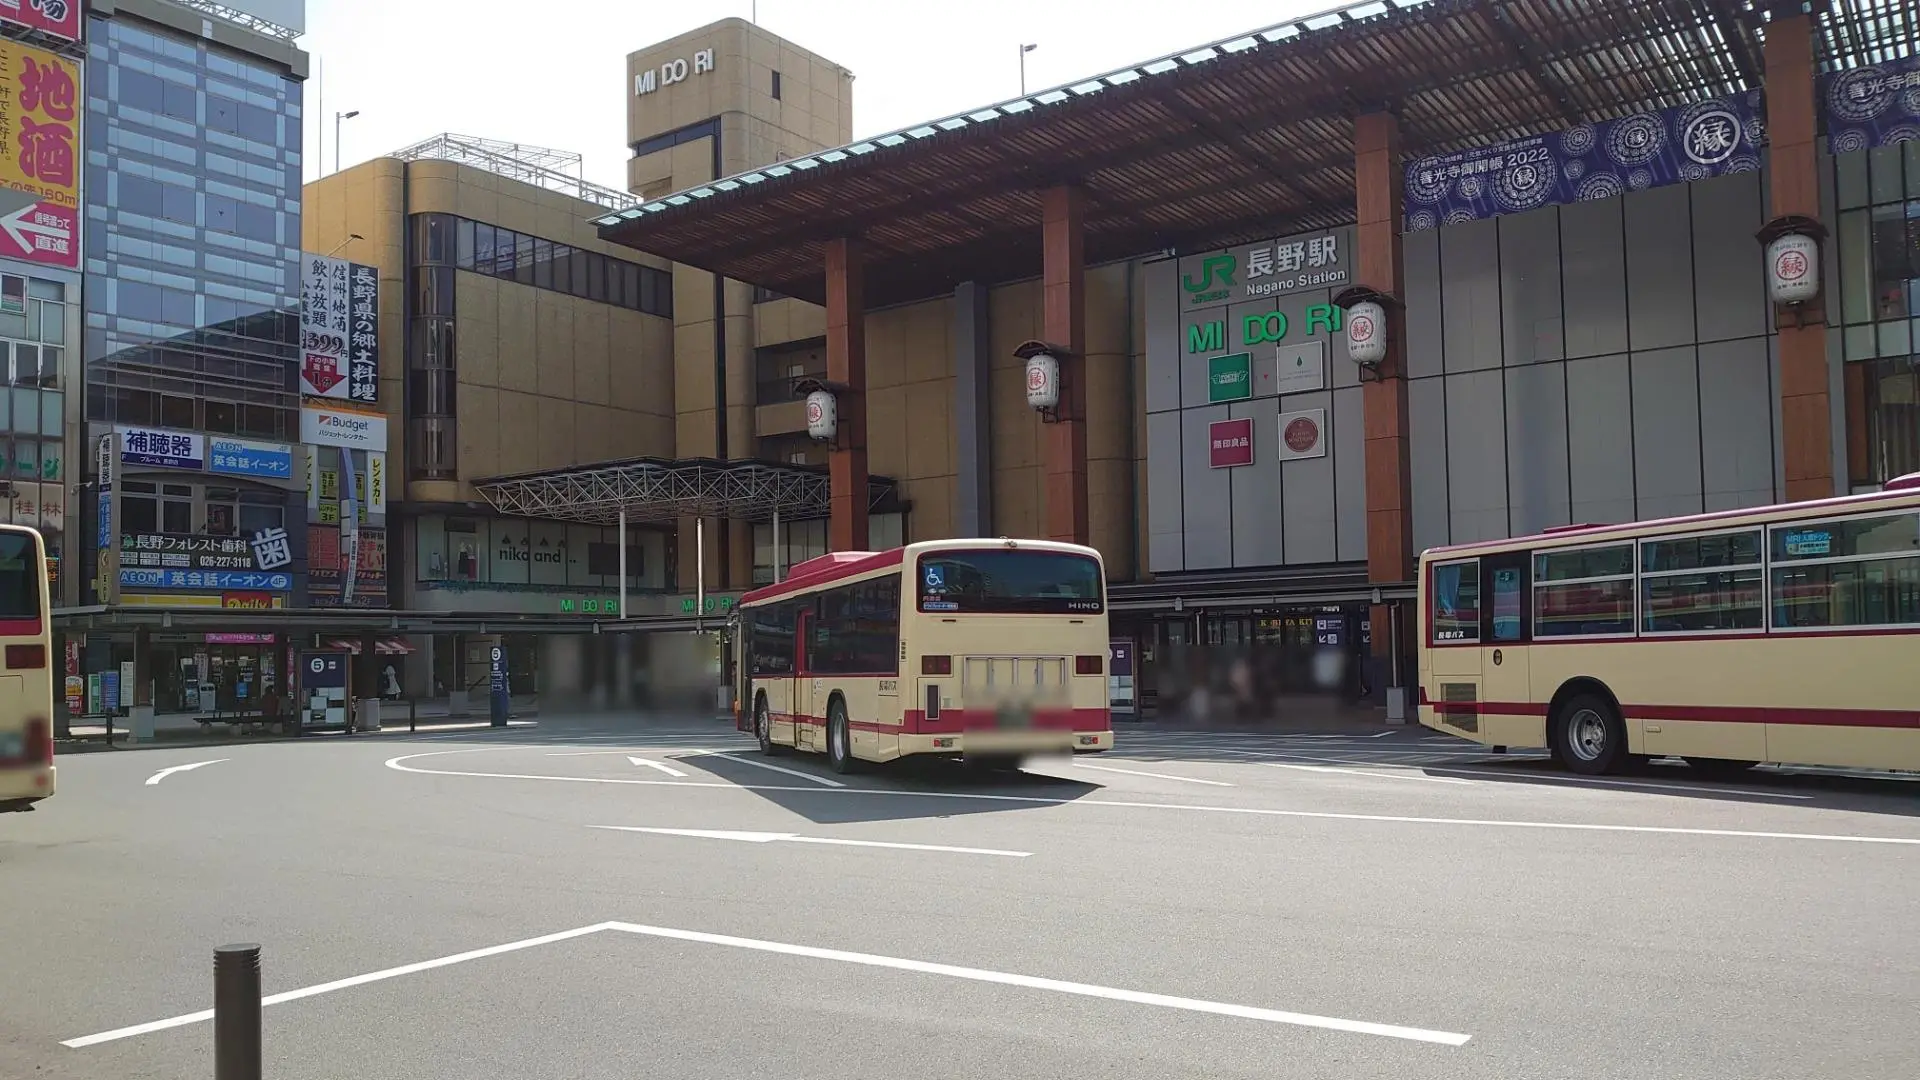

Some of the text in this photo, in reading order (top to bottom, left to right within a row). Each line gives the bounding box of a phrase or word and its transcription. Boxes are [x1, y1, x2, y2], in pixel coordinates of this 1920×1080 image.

[635, 48, 715, 97] MI DO RI
[18, 55, 75, 188] 地酒
[1694, 120, 1731, 156] 縁
[1420, 147, 1549, 185] 善光寺御開帳 2022
[34, 234, 69, 255] 直進
[1246, 236, 1339, 279] 長野駅
[1183, 254, 1236, 292] JR
[1246, 270, 1347, 297] Nagano Station
[311, 259, 328, 329] 飲み放題
[331, 264, 347, 333] 信州地酒
[351, 267, 377, 400] 長野県の郷土料理
[1189, 303, 1342, 353] MI DO RI
[332, 416, 368, 432] Budget
[127, 430, 192, 457] 補聴器
[1213, 436, 1249, 450] 無印良品
[213, 455, 289, 472] 英会話イーオン
[372, 458, 382, 505] レンタカー
[15, 500, 62, 515] 桂林
[136, 534, 247, 554] 長野フォレスト歯科
[251, 527, 292, 571] 歯
[533, 548, 561, 564] and
[200, 555, 251, 568] 026-227-3118
[121, 571, 158, 584] AEON
[171, 571, 268, 588] 英会話イーオン
[560, 600, 617, 613] MI DO RI
[681, 600, 694, 613] MI
[1067, 602, 1100, 610] HINO
